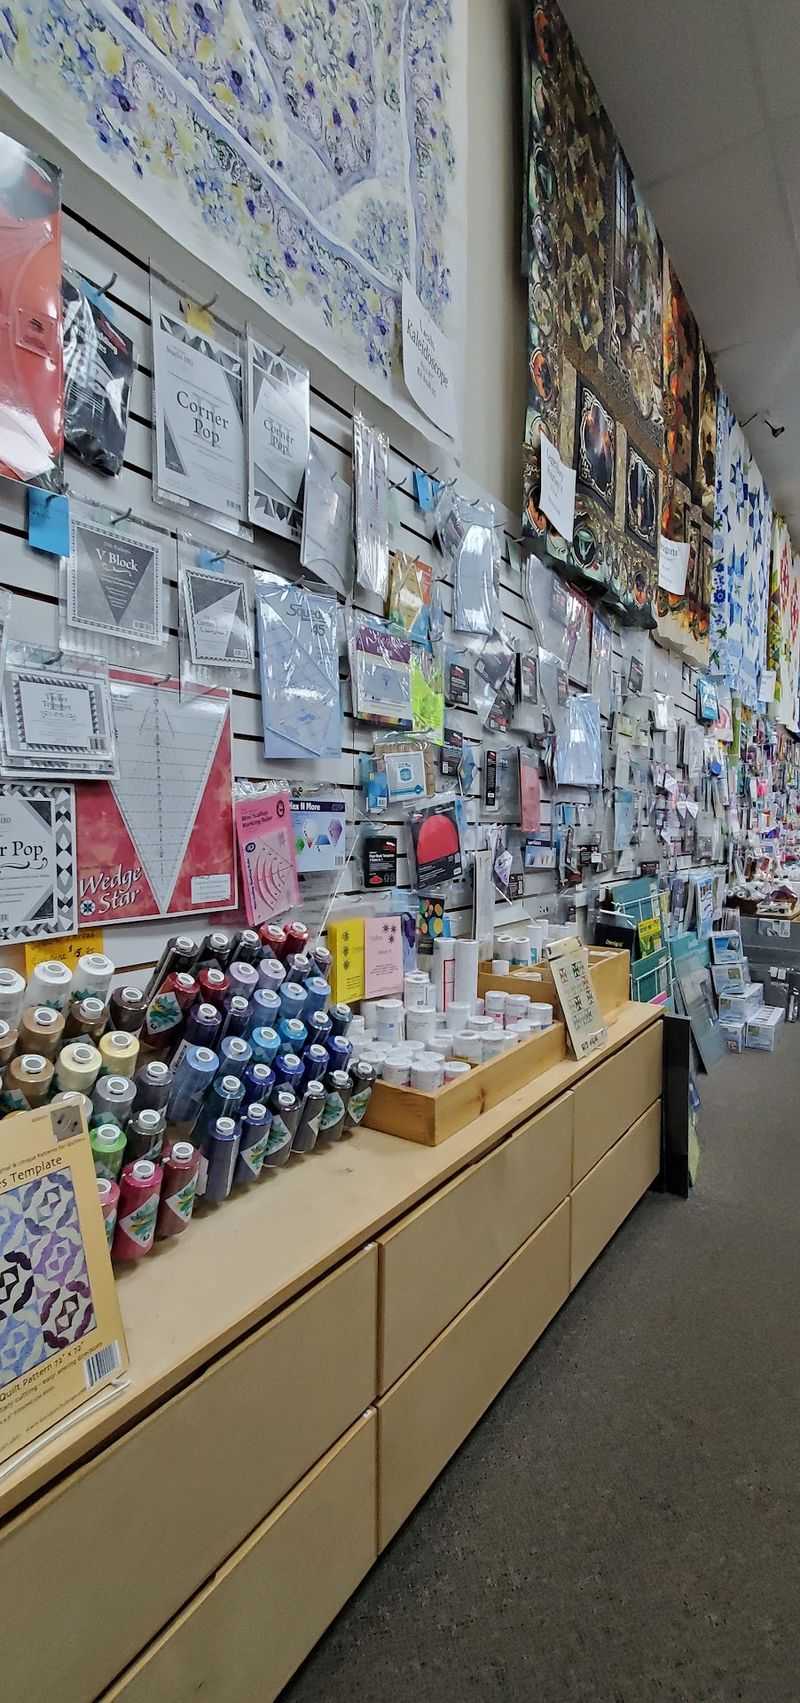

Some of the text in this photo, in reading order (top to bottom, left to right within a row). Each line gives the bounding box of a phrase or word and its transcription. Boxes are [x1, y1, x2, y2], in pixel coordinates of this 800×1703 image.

[407, 317, 449, 390] Kaleidoscope
[176, 391, 230, 430] Corner
[193, 417, 222, 448] Pop
[96, 548, 107, 561] V
[109, 551, 138, 572] Block
[306, 802, 321, 811] More
[12, 840, 43, 861] Pop
[80, 863, 143, 898] Wedge
[97, 889, 141, 915] Star
[10, 1155, 63, 1184] Template
[0, 1383, 20, 1403] Quilt
[22, 1362, 54, 1388] Pattern
